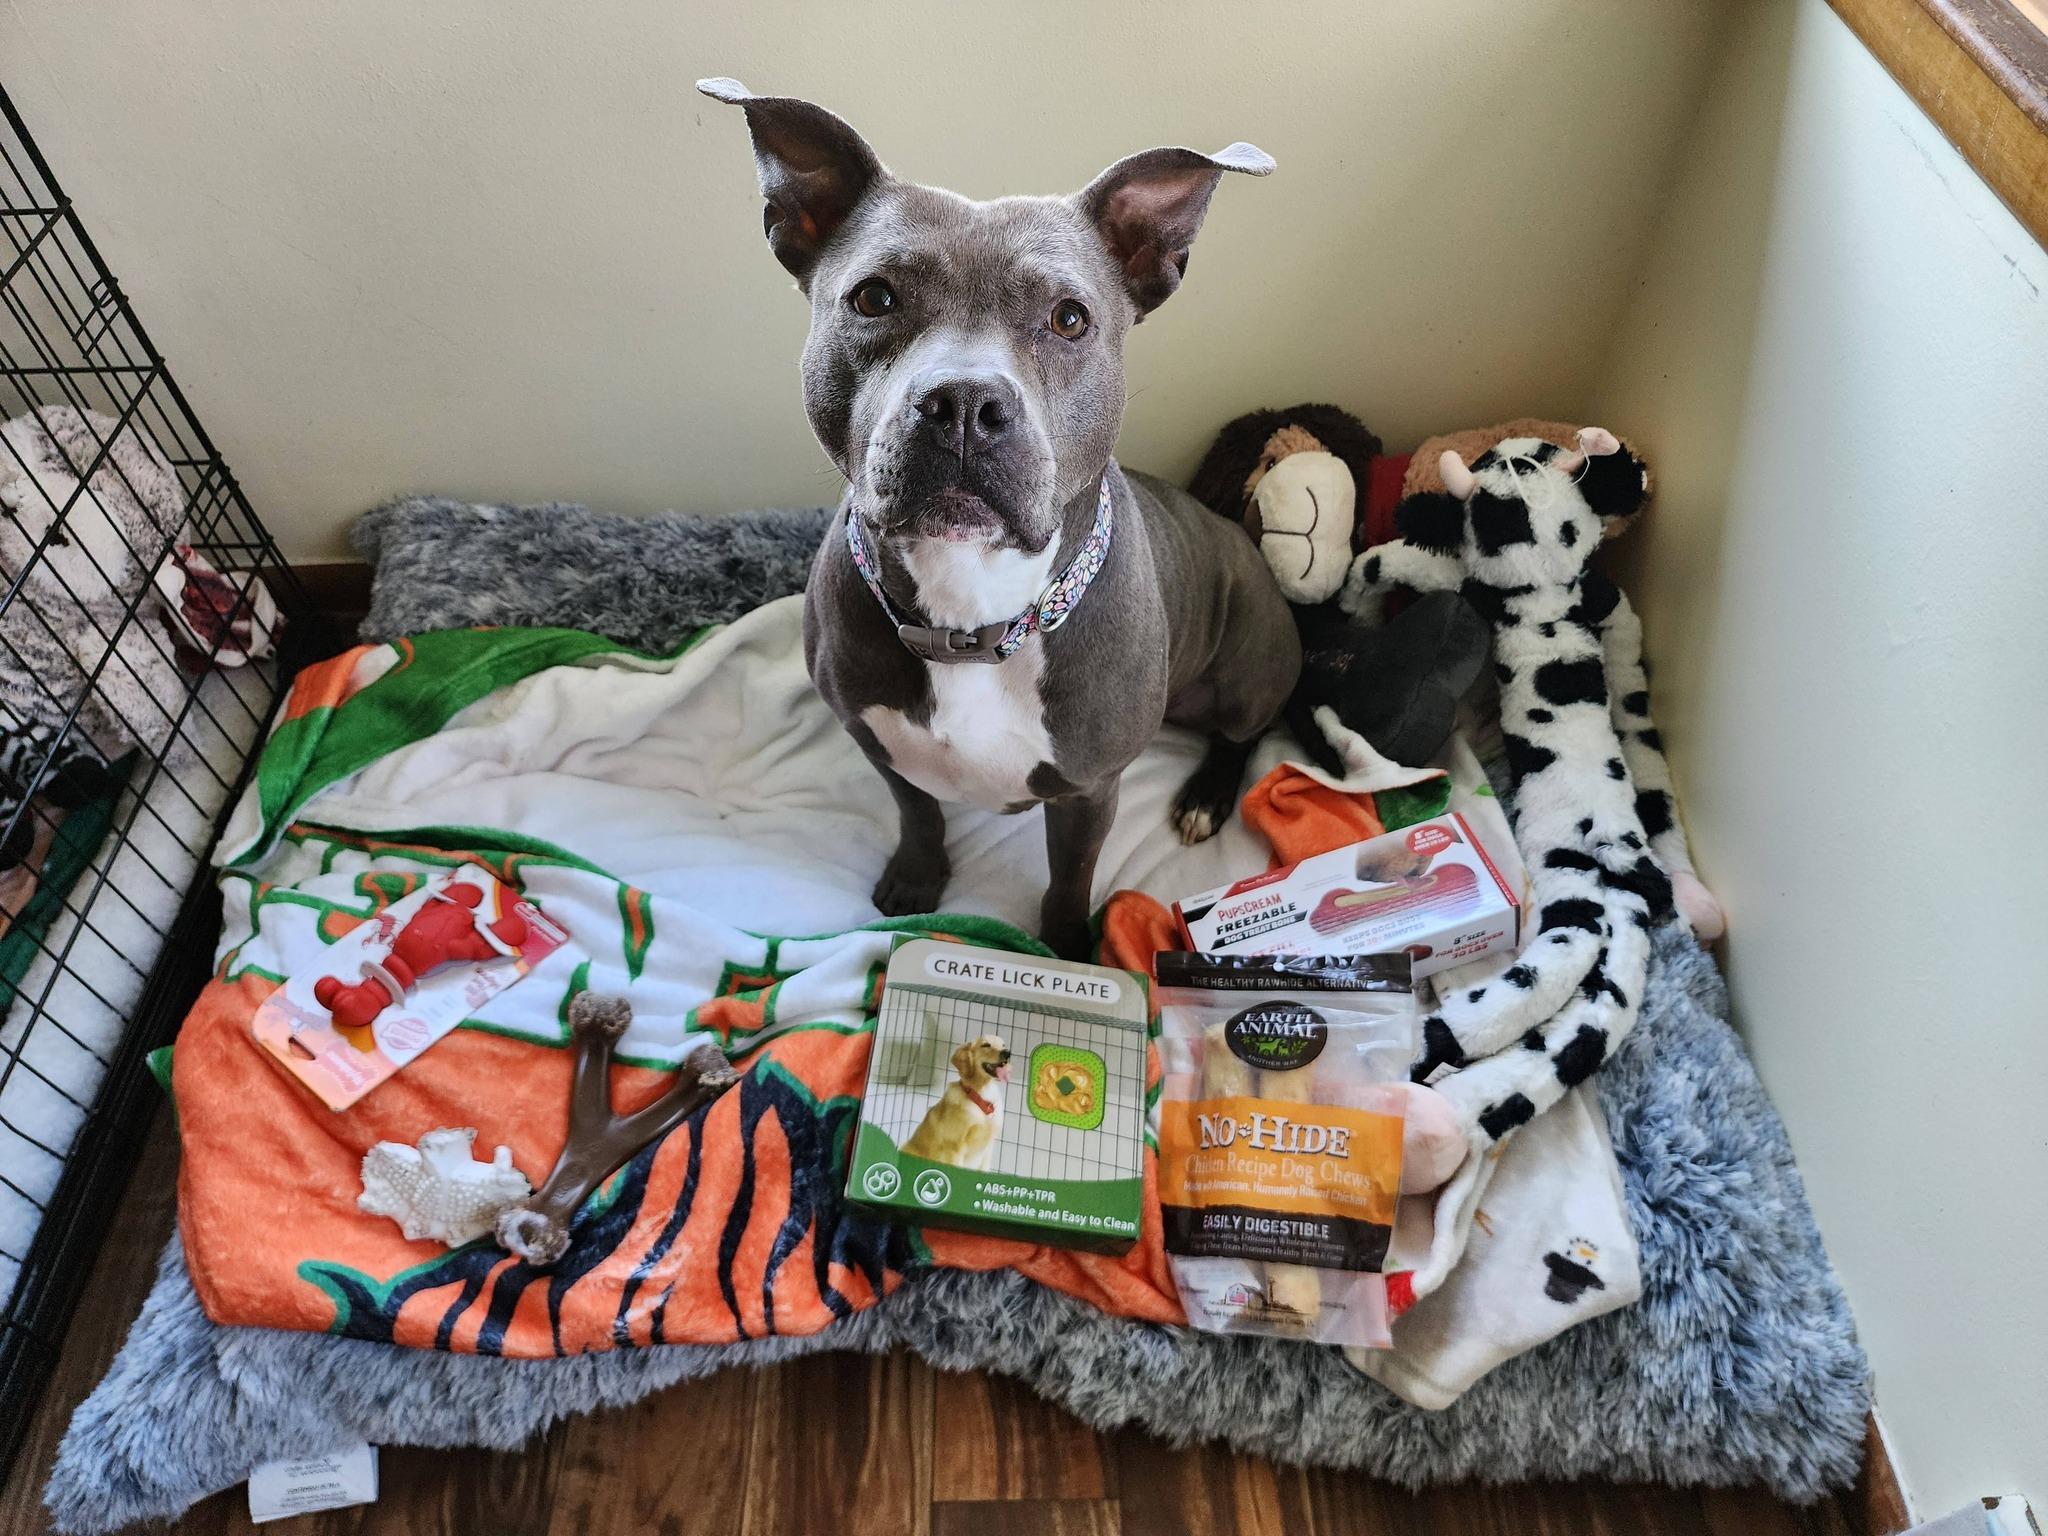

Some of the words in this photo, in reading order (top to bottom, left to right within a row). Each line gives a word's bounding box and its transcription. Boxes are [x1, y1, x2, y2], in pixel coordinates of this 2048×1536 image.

[1216, 902, 1297, 935] FREEZABLE
[1224, 932, 1243, 944] DOG
[1243, 922, 1271, 938] TREAT
[934, 959, 995, 980] CRATE
[1002, 969, 1045, 988] LICK
[1052, 977, 1109, 998] PLATE
[1191, 976, 1208, 986] THE
[1210, 977, 1254, 988] HEALTHY
[1257, 977, 1303, 988] RAWHIDE
[1233, 1021, 1318, 1039] ANIMAL
[1244, 1012, 1313, 1023] EARTH
[1227, 1151, 1278, 1181] Recipe
[1280, 1157, 1315, 1186] Dog
[1319, 1159, 1371, 1189] Chews
[982, 1199, 1036, 1217] Washable
[1038, 1208, 1060, 1221] and
[1061, 1210, 1087, 1226] Easy
[1089, 1215, 1102, 1226] to
[1103, 1216, 1136, 1232] Clean
[1203, 1214, 1242, 1230] EASILY
[1244, 1216, 1330, 1239] DIGESTIBLE
